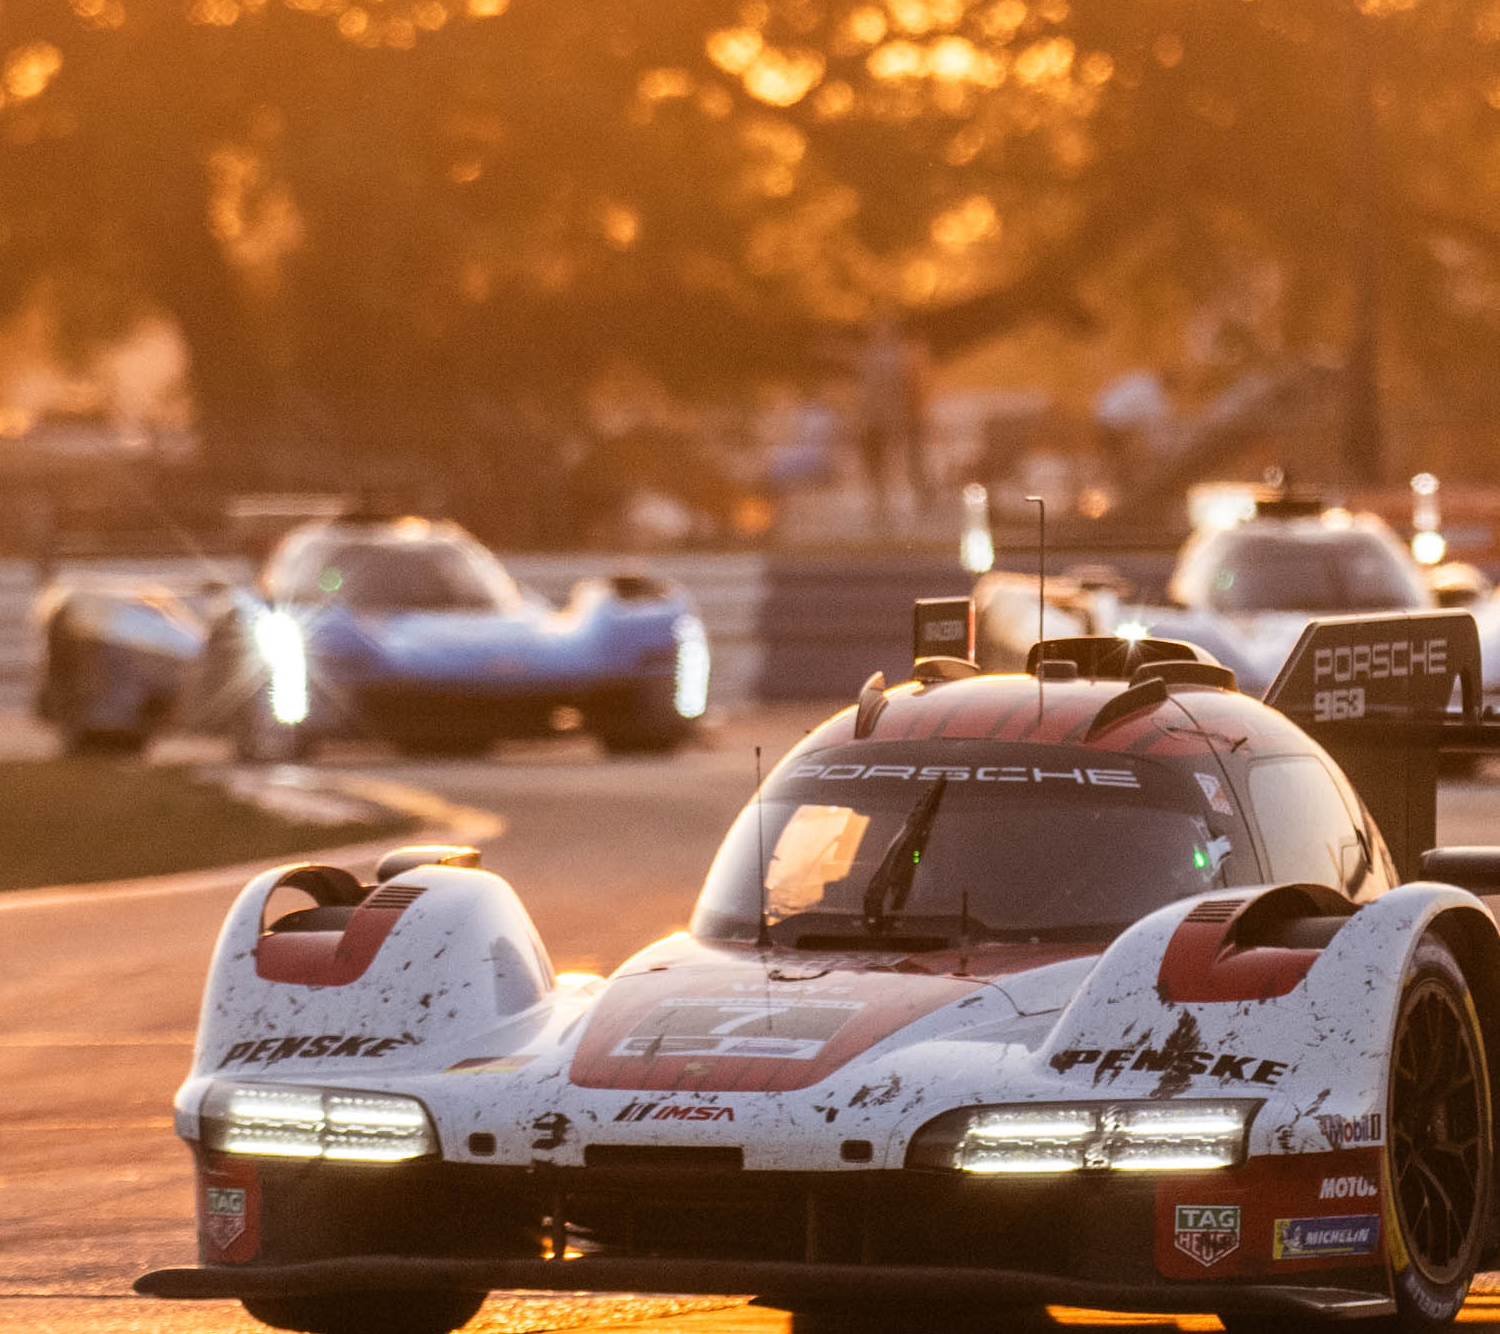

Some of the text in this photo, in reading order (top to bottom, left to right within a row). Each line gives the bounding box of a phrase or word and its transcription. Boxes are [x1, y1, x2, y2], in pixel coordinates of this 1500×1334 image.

[1314, 639, 1447, 684] PORSCHE
[1315, 687, 1366, 722] 963
[787, 764, 1141, 789] PORSCHE
[709, 1006, 790, 1035] 7
[217, 1034, 405, 1069] PENSKE
[1053, 1048, 1290, 1086] PENSKE
[650, 1105, 736, 1122] IMSA
[207, 1193, 244, 1213] TAG
[1182, 1209, 1235, 1228] TAG
[1305, 1227, 1371, 1245] MICHELIN
